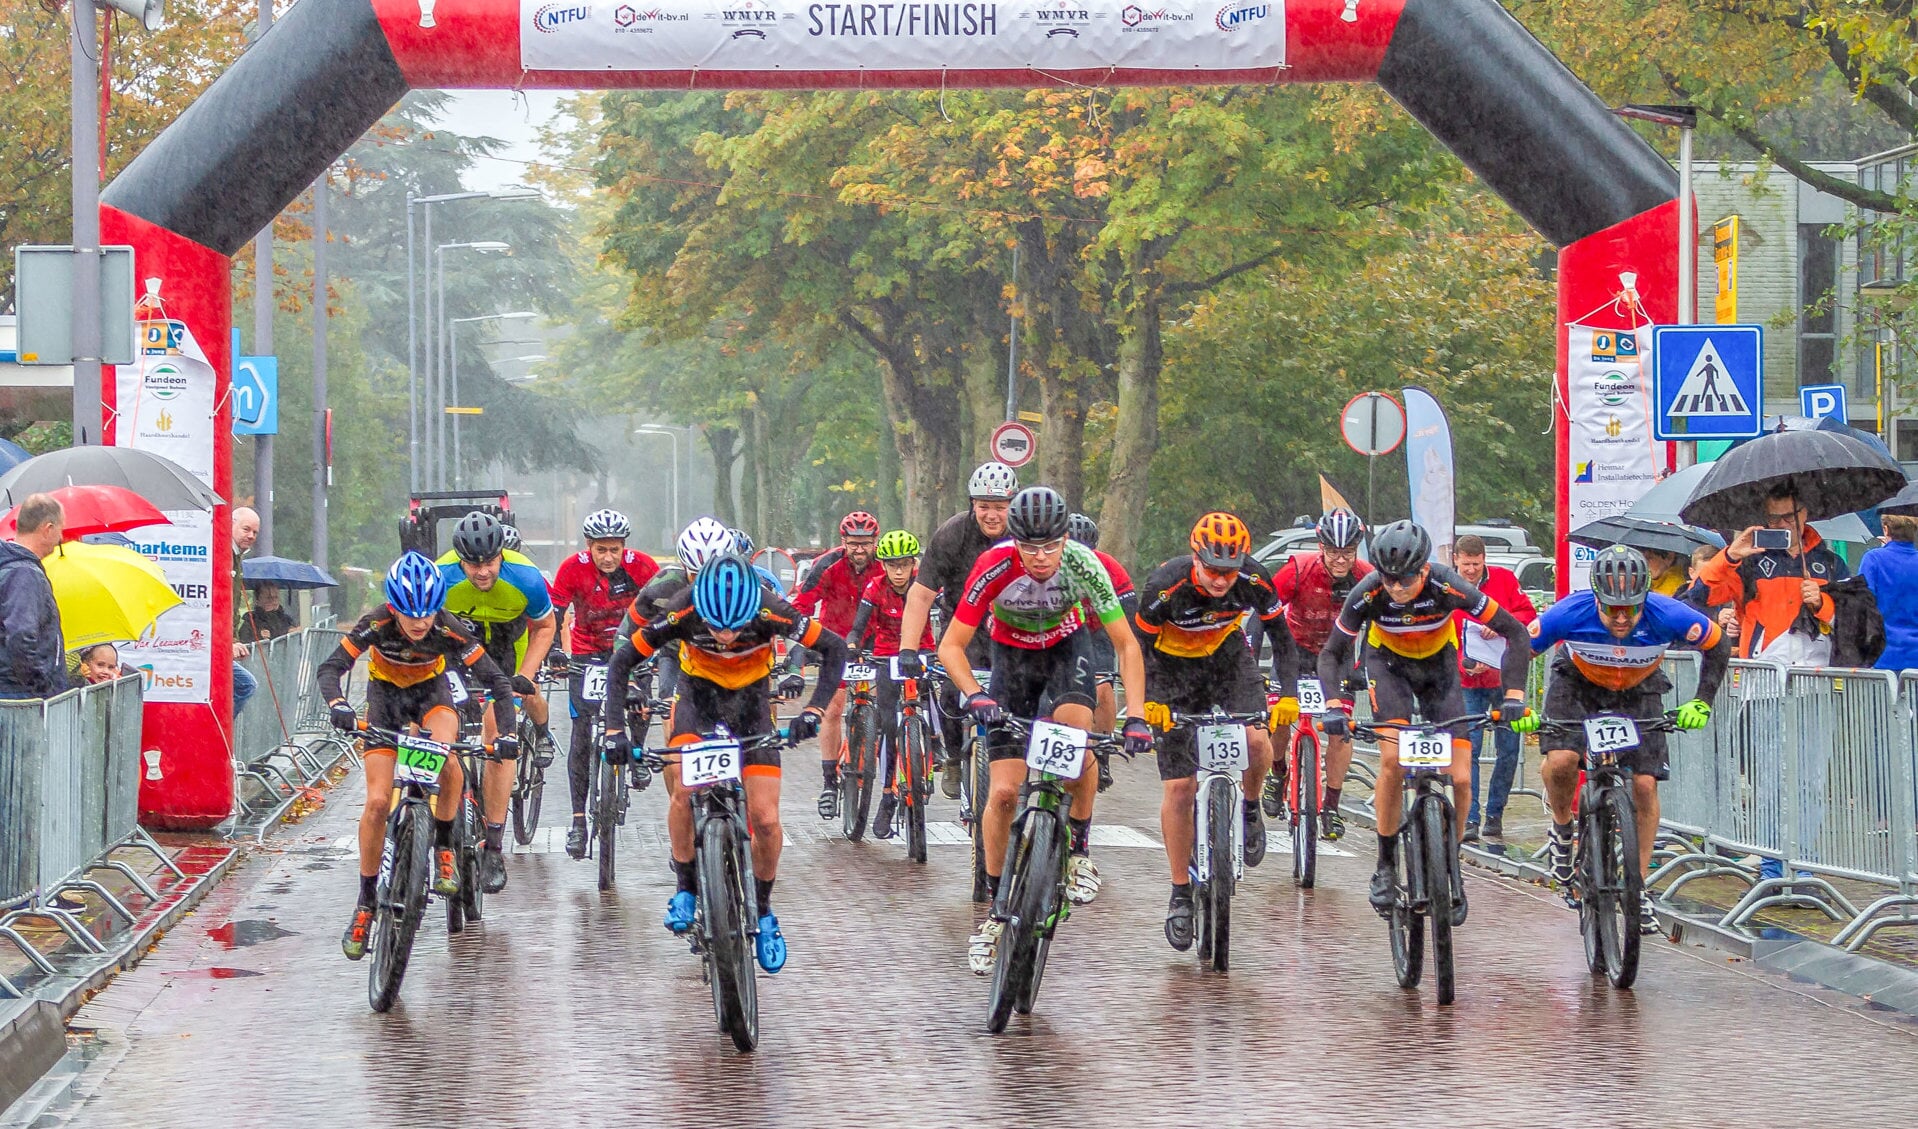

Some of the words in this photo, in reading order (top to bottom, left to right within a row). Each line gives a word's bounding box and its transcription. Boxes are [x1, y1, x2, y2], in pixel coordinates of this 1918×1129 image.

[548, 6, 587, 26] NTFU
[722, 10, 777, 21] WMVR
[808, 3, 997, 36] START/FINISH
[1037, 10, 1089, 20] WMVR
[1229, 5, 1267, 25] NTFU
[145, 375, 187, 384] Fundeon
[1594, 382, 1635, 390] Fundeon
[1811, 392, 1836, 419] P
[1580, 499, 1617, 508] GOLDEN
[155, 674, 193, 687] hets
[591, 678, 608, 690] 17
[1595, 725, 1628, 741] 171
[1040, 737, 1076, 762] 163
[1207, 741, 1240, 760] 135
[1408, 741, 1443, 755] 180
[692, 753, 731, 772] 176
